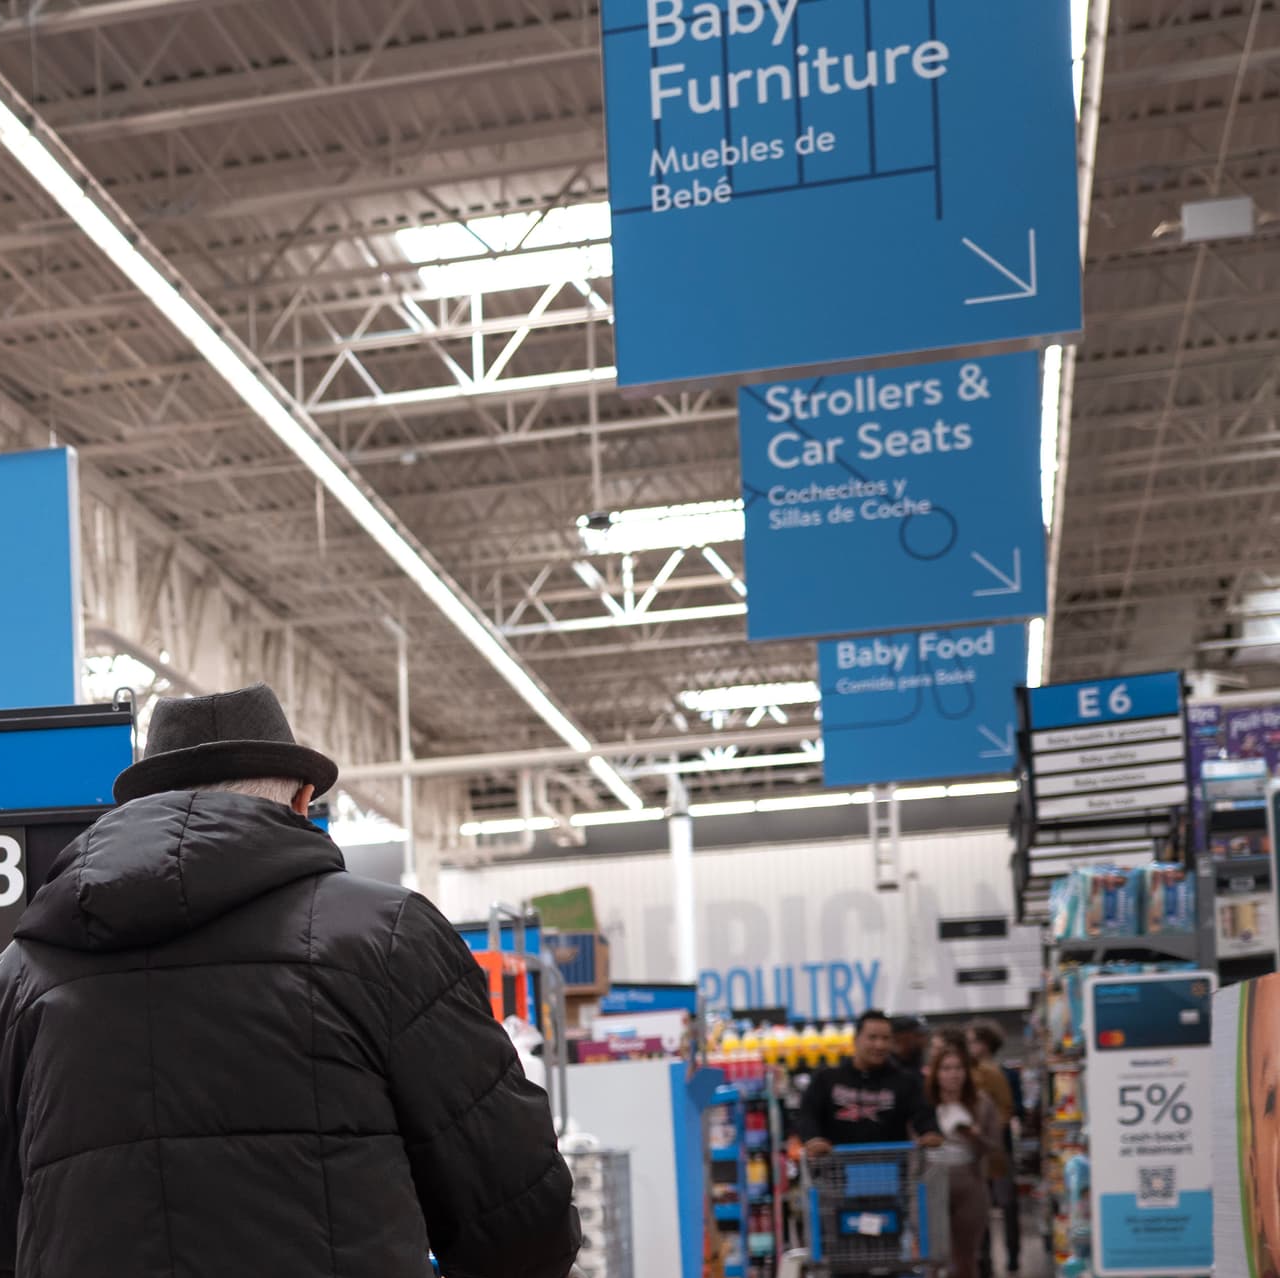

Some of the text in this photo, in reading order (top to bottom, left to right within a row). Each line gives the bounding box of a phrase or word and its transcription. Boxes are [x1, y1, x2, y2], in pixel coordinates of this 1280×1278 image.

[647, 0, 799, 48] Baby
[649, 39, 950, 120] Furniture
[648, 127, 835, 177] Muebles de
[651, 177, 732, 213] Bebé
[765, 363, 990, 423] Strollers &
[767, 419, 973, 469] Car Seats
[768, 478, 907, 506] Cochecitos y
[768, 498, 931, 530] Sillas de Coche
[836, 629, 995, 671] Baby Food
[698, 960, 881, 1023] POULTRY
[1117, 1083, 1193, 1126] 5%
